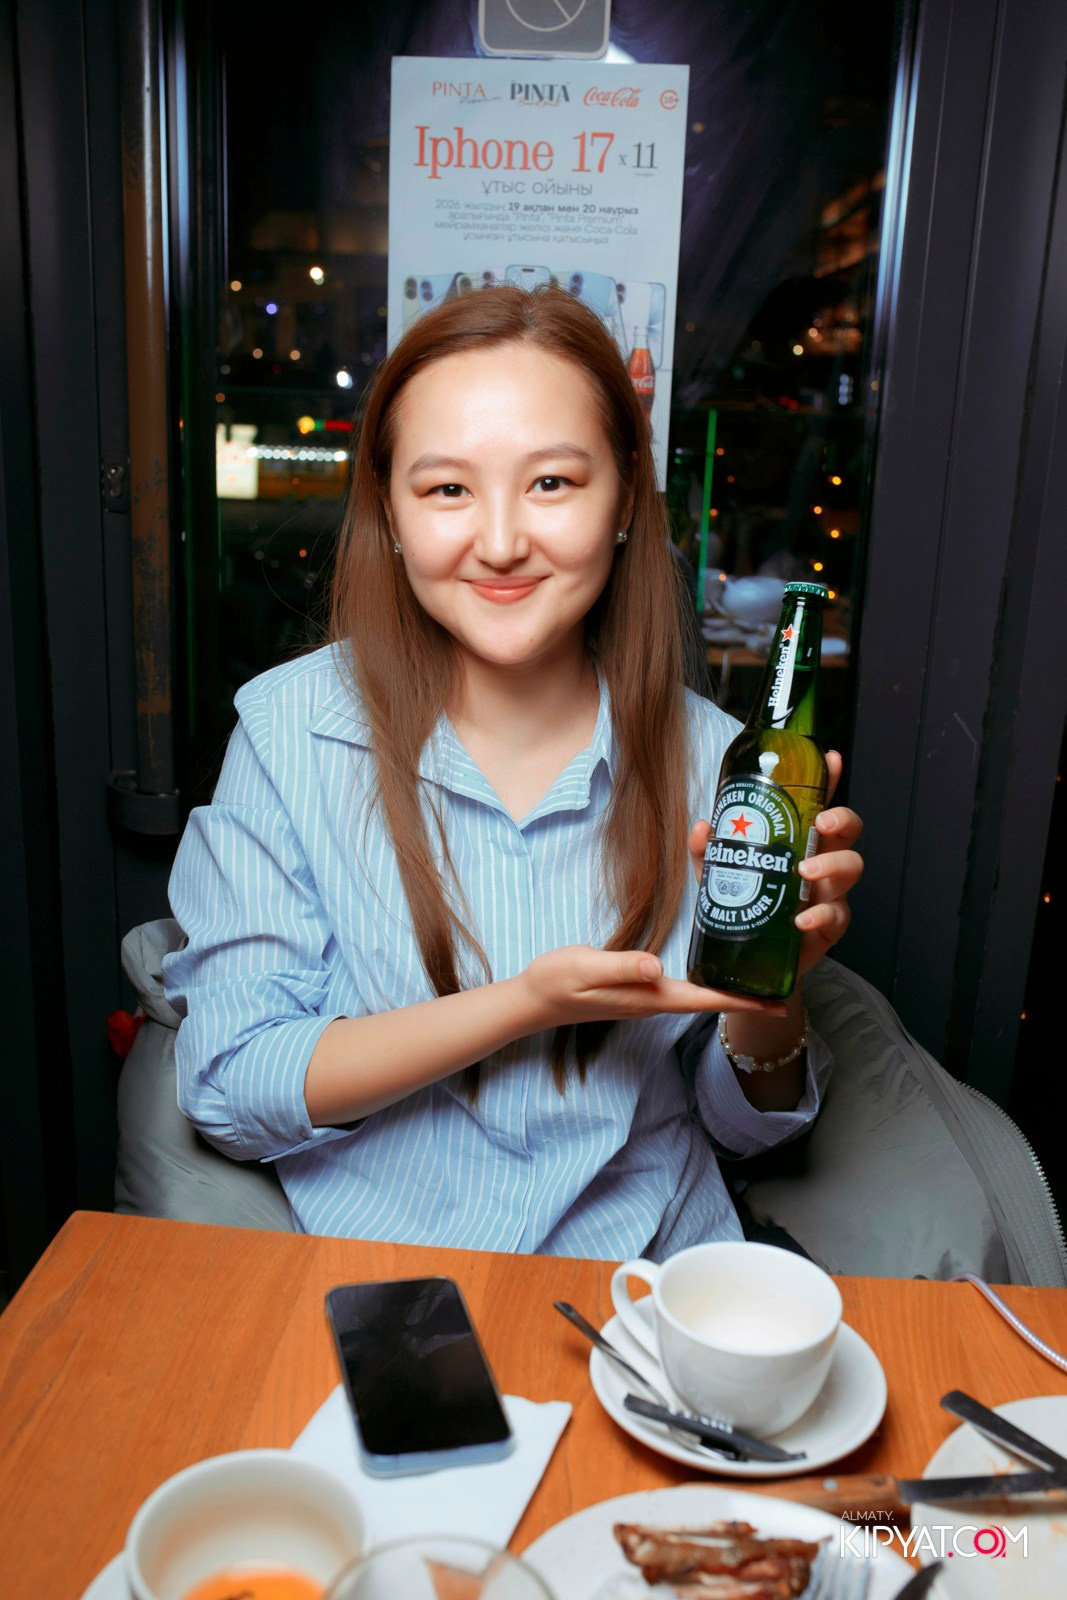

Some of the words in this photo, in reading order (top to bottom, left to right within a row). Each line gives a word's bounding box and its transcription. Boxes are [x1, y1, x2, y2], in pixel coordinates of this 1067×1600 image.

[432, 80, 486, 98] PINTA
[510, 82, 571, 102] PINTA
[413, 125, 554, 180] Iphone
[571, 131, 615, 173] 17
[632, 142, 659, 169] 11
[508, 201, 521, 212] 19
[557, 204, 580, 214] мен
[582, 203, 597, 214] 20
[767, 646, 791, 708] Heineken
[711, 790, 746, 829] HEINEKEN
[747, 791, 787, 837] ORIGINAL
[704, 842, 789, 873] Heineken
[709, 906, 738, 923] MALT
[740, 894, 774, 922] LAGER
